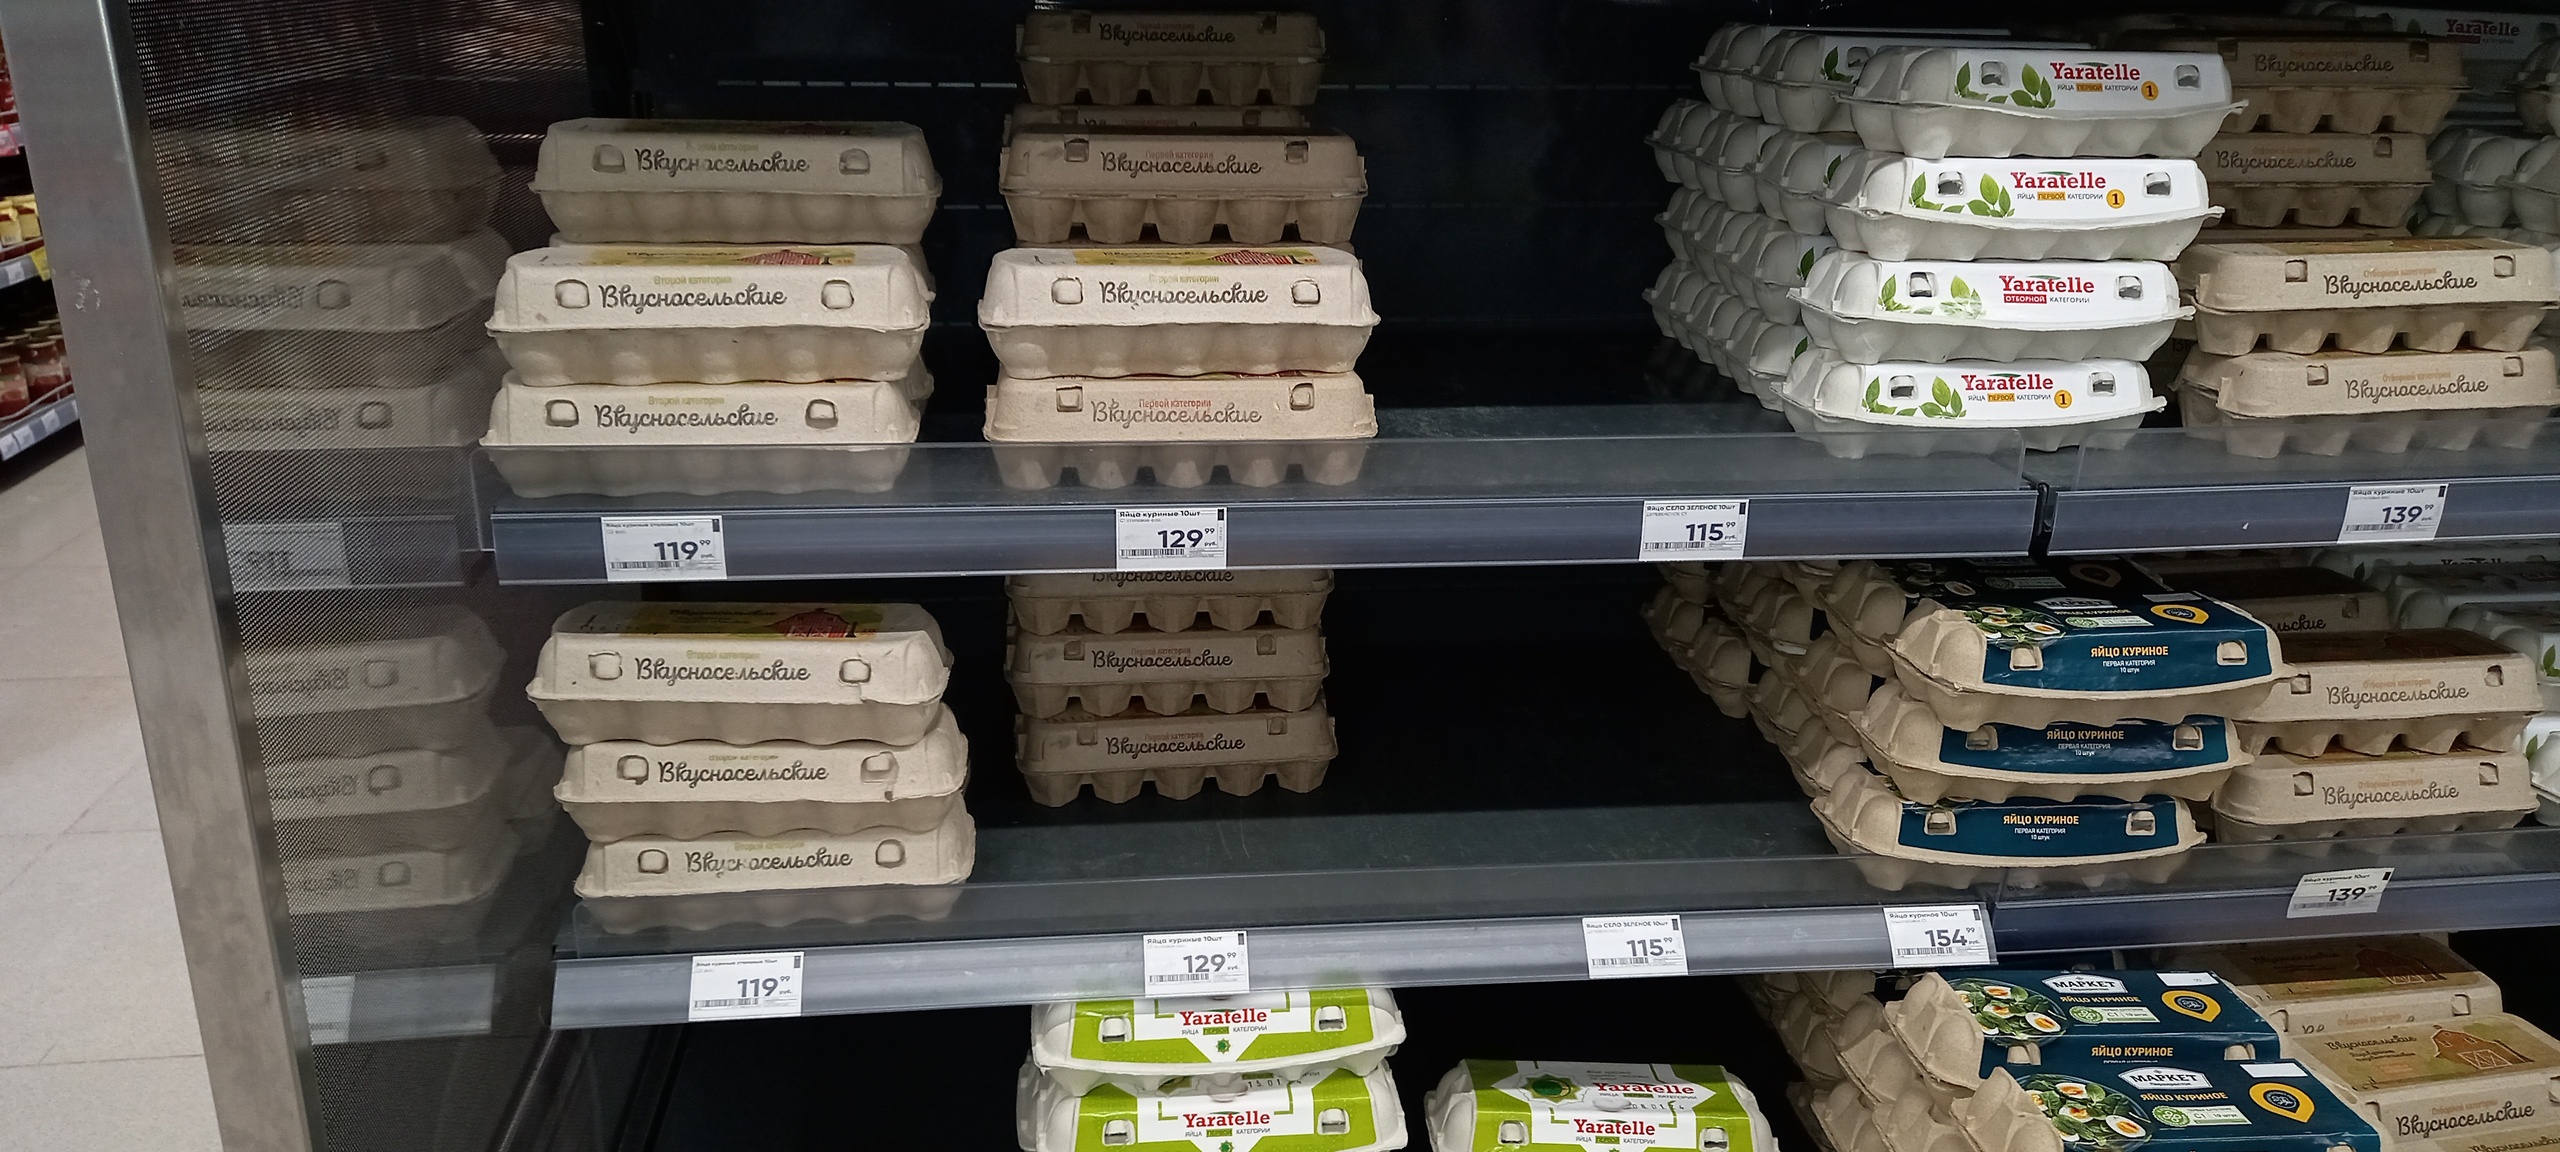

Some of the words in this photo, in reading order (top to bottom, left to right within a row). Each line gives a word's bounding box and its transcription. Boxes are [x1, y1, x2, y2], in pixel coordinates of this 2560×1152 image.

[1099, 23, 1235, 46] Вкусносельские
[2446, 19, 2519, 36] Yaratelle
[2050, 62, 2140, 80] Yaratelle
[2254, 53, 2393, 77] Вкусносельские
[2057, 83, 2074, 92] ЯЙЦА
[2104, 84, 2138, 92] КАТЕГОРИИ
[1100, 151, 1262, 178] Вкусносельские
[2216, 151, 2356, 174] Вкусносельские
[2011, 171, 2106, 189] Yaratelle
[2017, 192, 2035, 200] ЯЙЦА
[2037, 192, 2066, 201] ПЕРВОЙ
[1999, 275, 2095, 293] Yaratelle
[2323, 270, 2478, 300] Вкусносельские
[598, 283, 787, 314] Вкусносельские
[1099, 281, 1268, 310] Вкусносельские
[2005, 294, 2046, 304] ОТБОРНОЙ
[1961, 374, 2053, 390] Yaratelle
[2345, 374, 2488, 404] Вкусносельские
[1139, 399, 1169, 408] Первой
[1170, 400, 1211, 409] категории
[1967, 394, 1986, 402] ЯЙЦА
[594, 404, 778, 434] Вкусносельские
[1091, 399, 1262, 429] Вкусносельские
[1142, 511, 1179, 519] куриные
[2382, 506, 2422, 523] 139
[1157, 529, 1203, 548] 129
[1685, 523, 1724, 541] 115
[654, 541, 699, 561] 119
[1092, 649, 1233, 673] Вкусносельские
[2091, 646, 2120, 658] ЯЙЦО
[2122, 646, 2169, 656] КУРИНОЕ
[635, 658, 811, 686] Вкусносельские
[2326, 681, 2469, 710] Вкусносельские
[2046, 730, 2076, 741] ЯЙЦО
[2078, 730, 2124, 740] КУРИНОЕ
[1105, 733, 1246, 759] Вкусносельские
[658, 760, 829, 789] Вкусносельские
[2322, 781, 2459, 809] Вкусносельские
[2003, 814, 2032, 825] ЯЙЦО
[2034, 815, 2080, 825] КУРИНОЕ
[2328, 887, 2366, 901] 139
[1925, 929, 1968, 947] 154
[1626, 939, 1664, 956] 115
[1183, 954, 1226, 973] 129
[737, 978, 778, 997] 119
[2053, 981, 2116, 989] МАРКЕТ
[1180, 1008, 1267, 1026] Yaratelle
[1233, 1025, 1267, 1033] КАТЕГОРИИ
[2091, 1045, 2122, 1058] ЯЙЦО
[2125, 1046, 2173, 1057] КУРИНОЕ
[2130, 1074, 2198, 1083] МАРКЕТ
[1593, 1082, 1695, 1094] Yaratelle
[2140, 1092, 2174, 1102] ЯЙЦО
[2175, 1092, 2228, 1101] КУРИНОЕ
[1183, 1111, 1270, 1128] Yaratelle
[1574, 1119, 1656, 1135] Yaratelle
[2396, 1100, 2535, 1138] Вкусносельские
